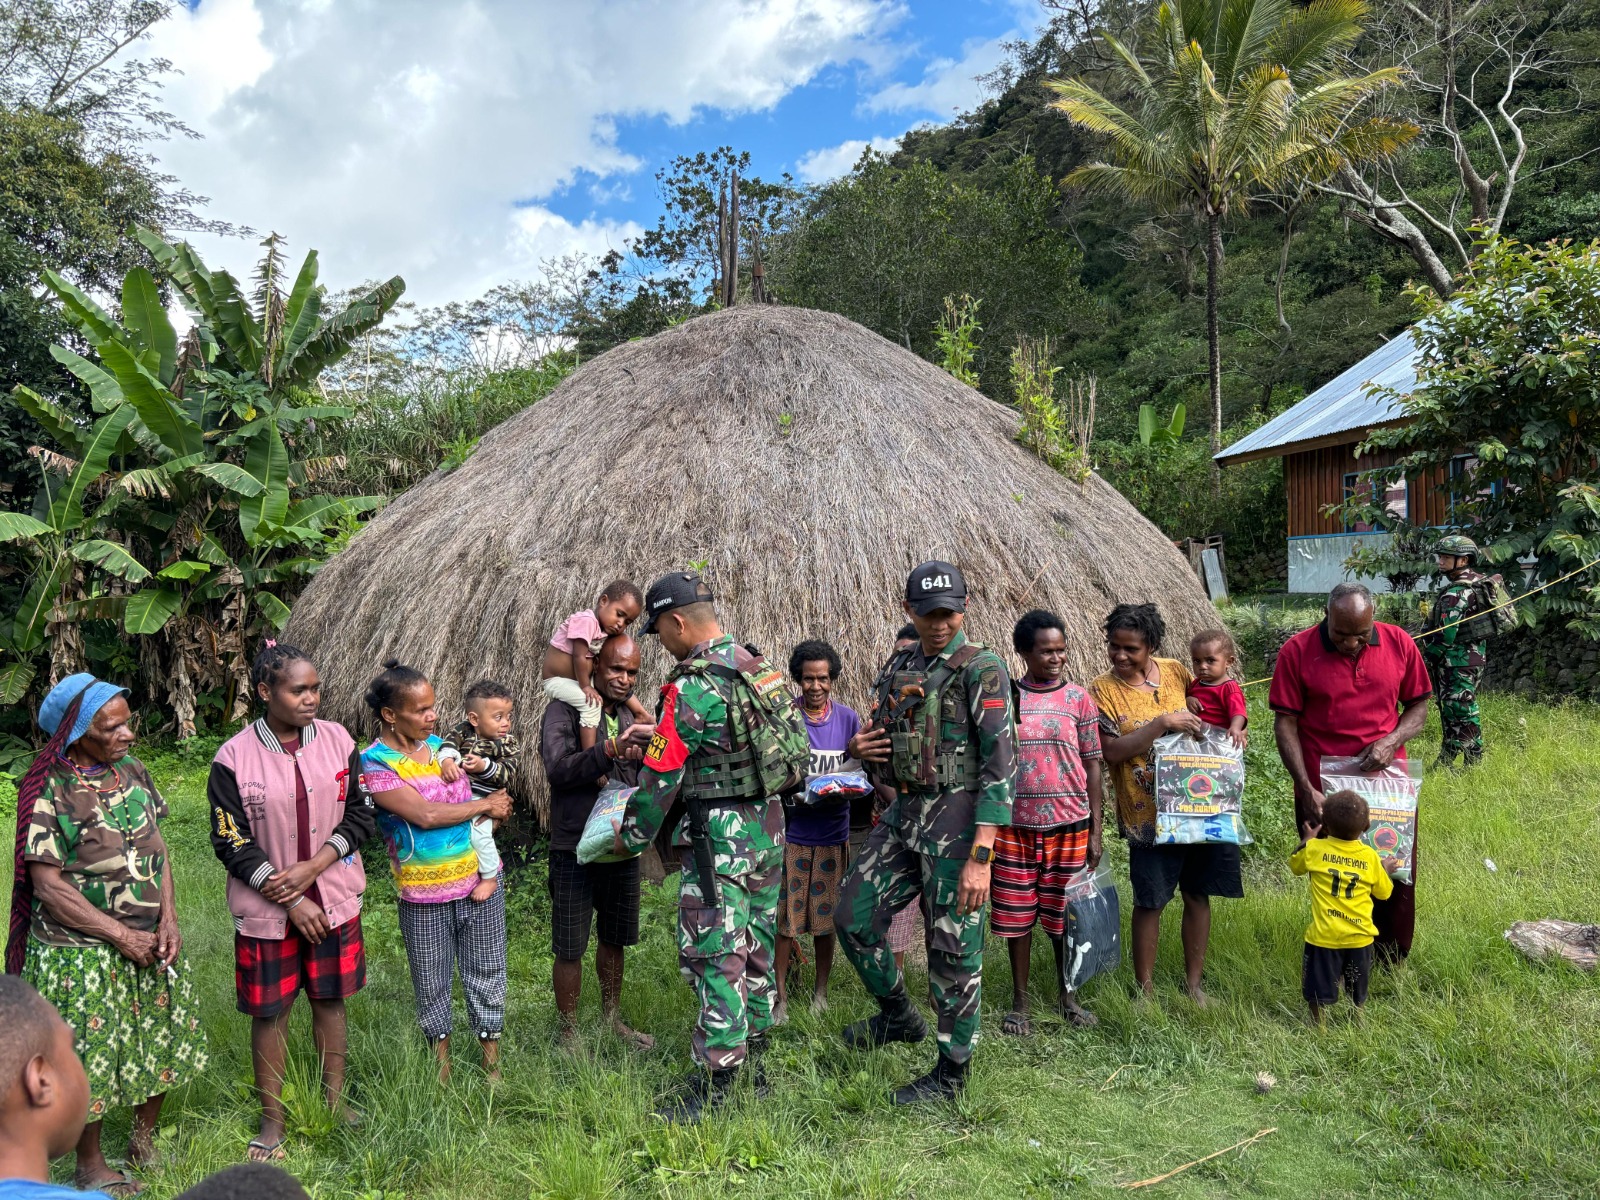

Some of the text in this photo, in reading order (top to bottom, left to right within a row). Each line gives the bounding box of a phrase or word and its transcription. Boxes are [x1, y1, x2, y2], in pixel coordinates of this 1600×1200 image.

[921, 575, 952, 590] 641
[1322, 853, 1368, 870] AUBAMEYANG
[1327, 868, 1360, 900] 17
